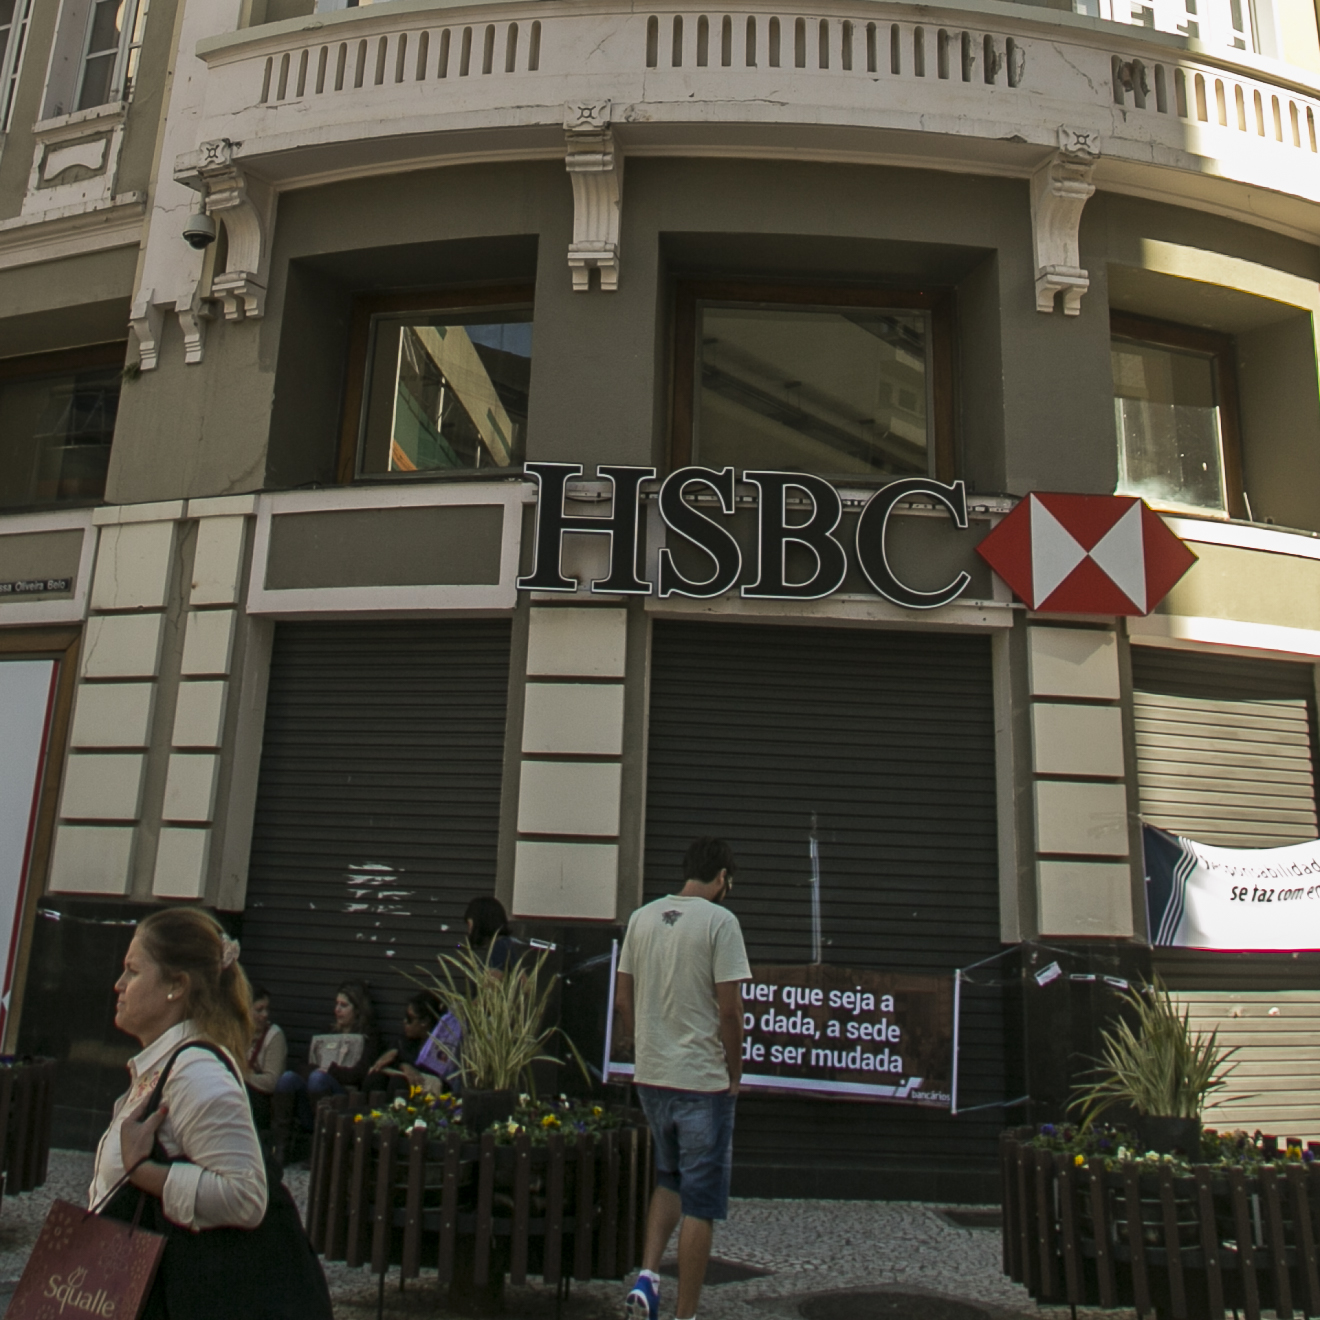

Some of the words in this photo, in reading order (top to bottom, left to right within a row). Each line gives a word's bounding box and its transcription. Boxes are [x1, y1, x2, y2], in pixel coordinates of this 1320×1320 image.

[516, 461, 972, 610] HSBC
[15, 581, 45, 593] Oliveira
[47, 579, 66, 590] Belo
[1230, 885, 1248, 901] se
[1251, 884, 1276, 902] faz
[1277, 887, 1305, 902] com
[740, 982, 777, 1002] uer
[782, 986, 824, 1010] que
[828, 985, 875, 1015] seja
[880, 994, 895, 1012] a
[760, 1008, 821, 1040] dada,
[826, 1019, 840, 1038] a
[846, 1018, 901, 1042] sede
[770, 1044, 806, 1064] ser
[811, 1045, 903, 1073] mudada
[911, 1089, 951, 1102] bancários
[43, 1274, 116, 1318] Squalle
